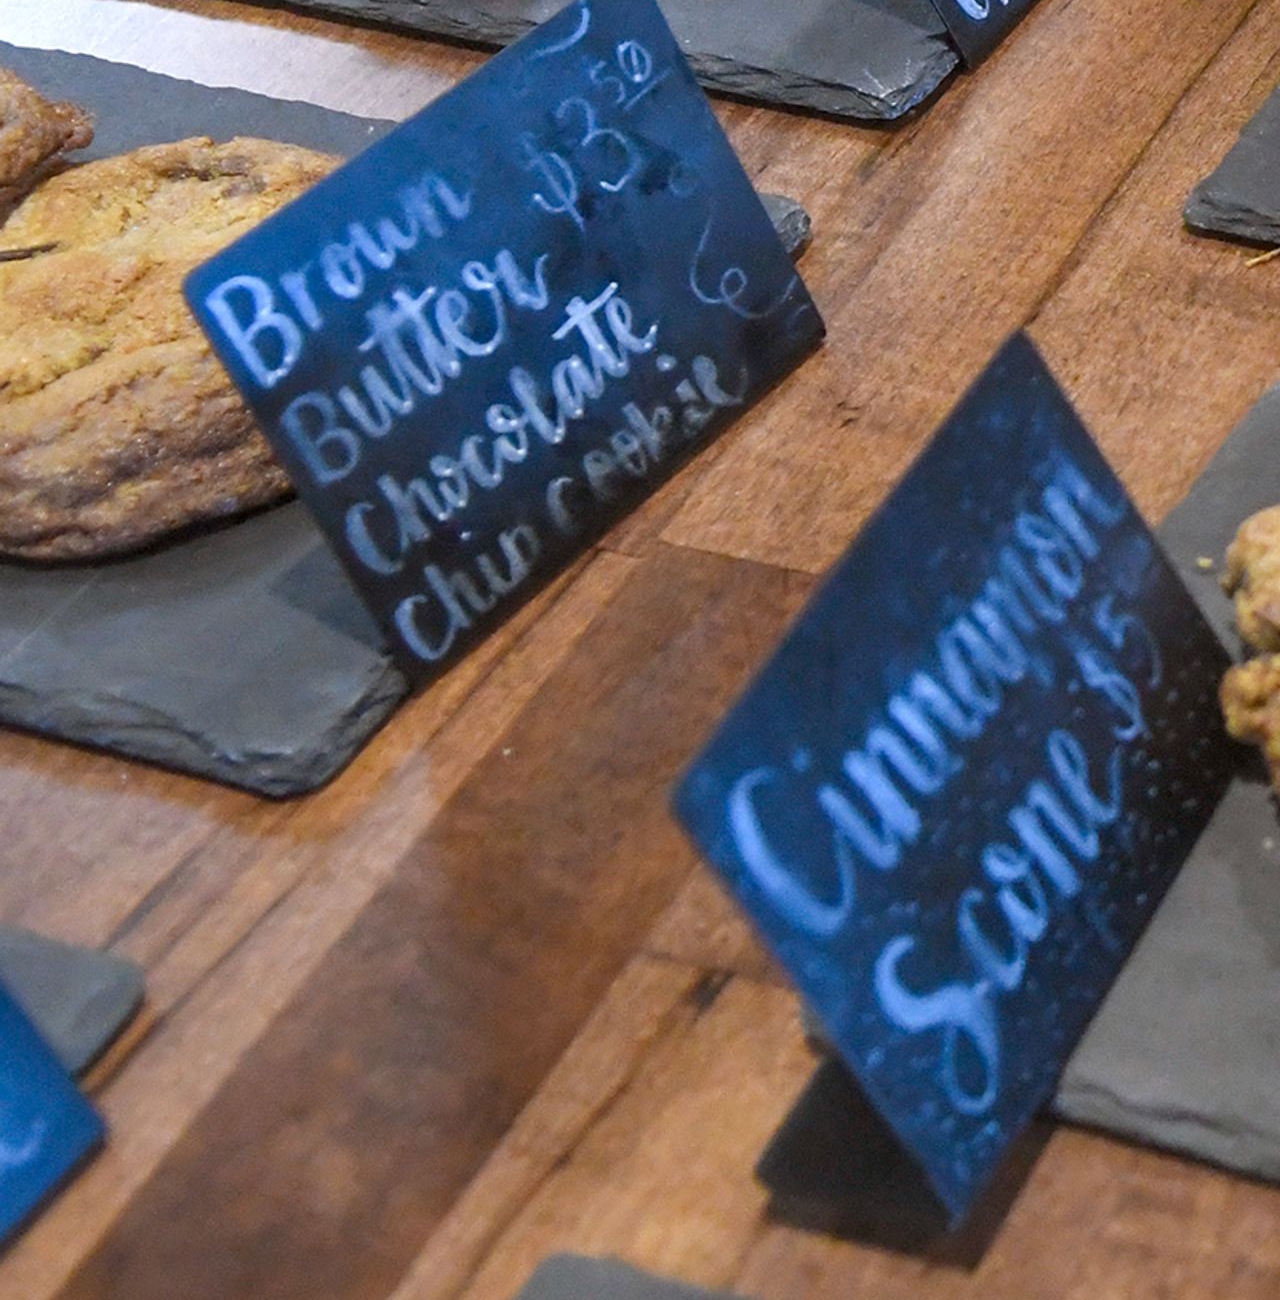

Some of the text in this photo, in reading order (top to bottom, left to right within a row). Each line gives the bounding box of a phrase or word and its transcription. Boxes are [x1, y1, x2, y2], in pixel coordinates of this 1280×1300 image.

[205, 171, 472, 390] Brown
[279, 252, 548, 487] Butter
[346, 282, 658, 577] Chocolate
[728, 443, 1128, 939] Cinnamon
[873, 601, 1163, 1117] Scone $5
